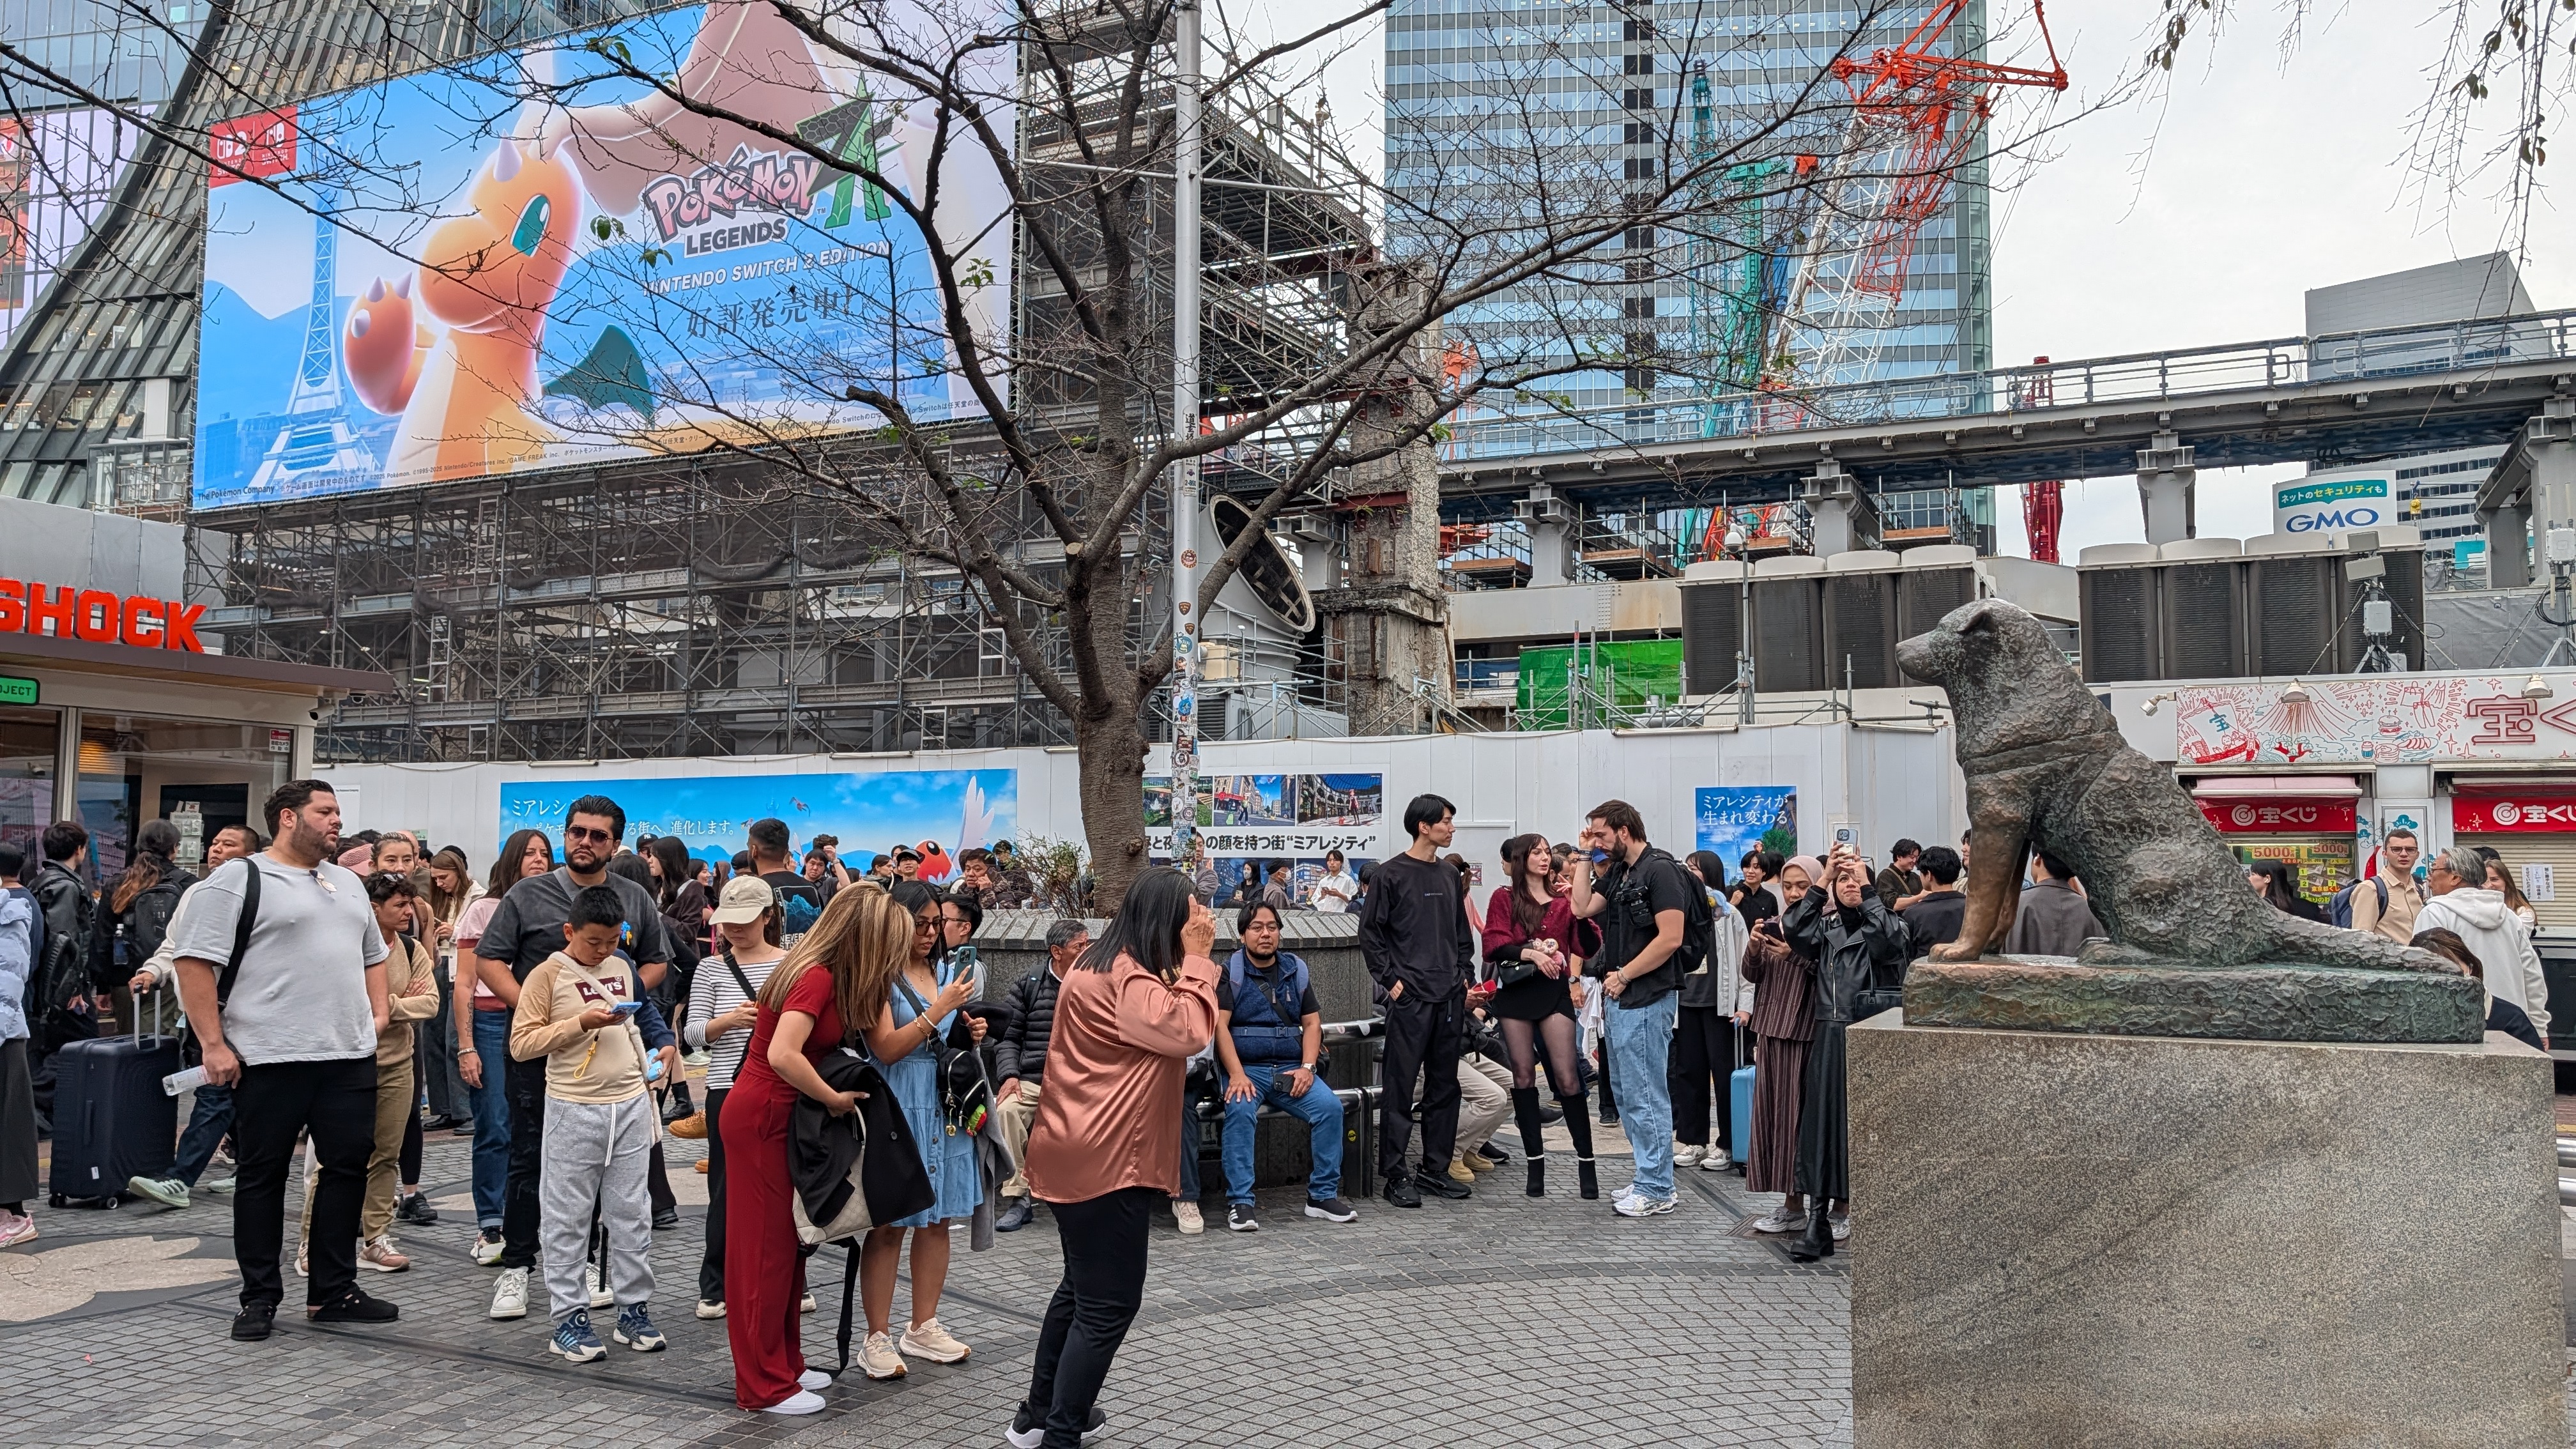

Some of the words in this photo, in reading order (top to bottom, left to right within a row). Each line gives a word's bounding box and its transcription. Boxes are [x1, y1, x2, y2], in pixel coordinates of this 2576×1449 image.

[686, 218, 786, 255] LEGENDS
[643, 268, 727, 296] NINTENDO
[732, 254, 798, 281] SWITCH
[803, 254, 815, 270] 2
[820, 239, 891, 267] EDITION
[198, 493, 210, 502] The
[211, 488, 242, 499] Pokémon
[243, 486, 275, 496] Company
[2281, 484, 2383, 503] ネットのセキュリティも
[2286, 508, 2379, 533] GMO
[512, 799, 578, 816] ミアレシ
[1703, 793, 1790, 809] ミアレシティが
[1703, 809, 1788, 825] 生まれ変わる
[2258, 806, 2317, 824] 宝くじ
[780, 933, 804, 942] NEVER
